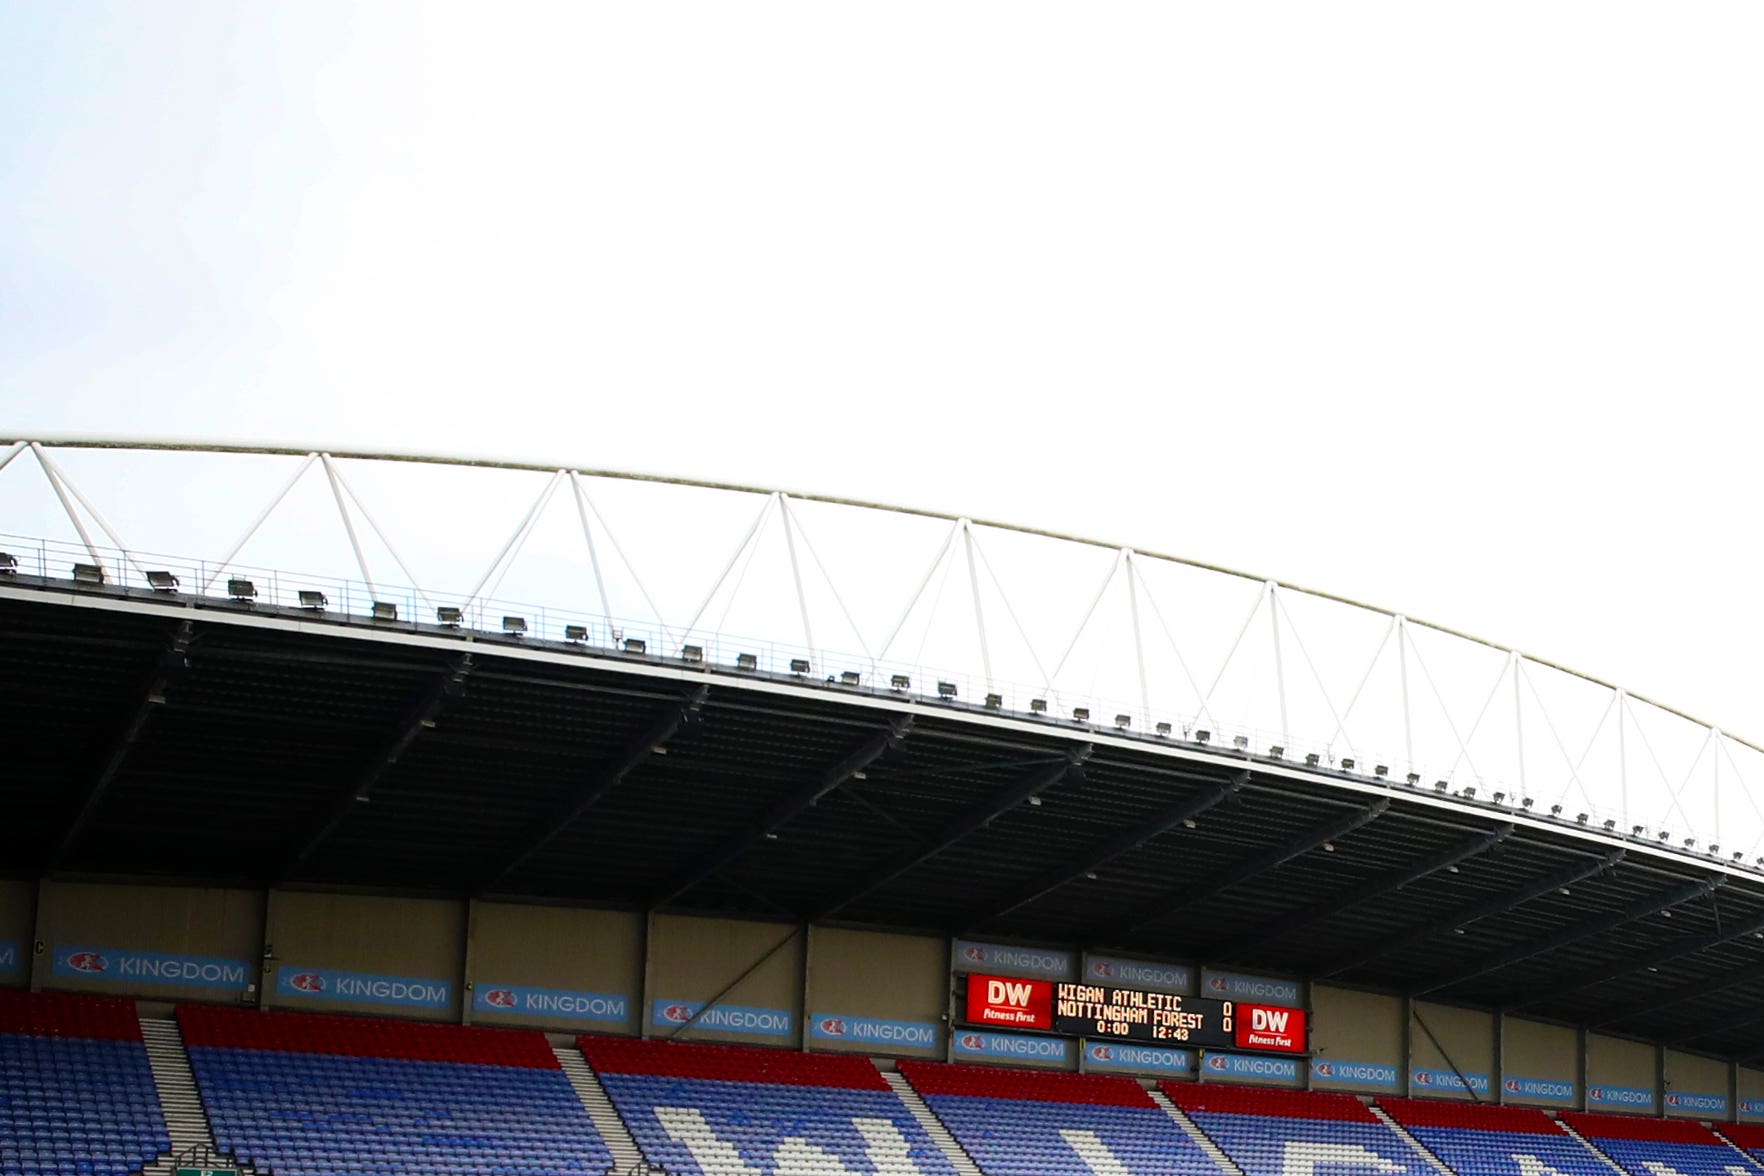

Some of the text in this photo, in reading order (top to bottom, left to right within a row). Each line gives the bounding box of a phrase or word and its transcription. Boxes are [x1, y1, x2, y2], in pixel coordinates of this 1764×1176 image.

[119, 957, 244, 982] KINGDOM
[993, 950, 1067, 972] KINGDOM
[1119, 965, 1188, 986] KINGDOM
[336, 977, 446, 1001] KINGDOM
[988, 980, 1033, 1007] DW
[1234, 979, 1296, 999] KINGDOM
[526, 993, 625, 1016] KINGDOM
[1058, 984, 1232, 1016] WIGAN ATHLETIC 0
[700, 1010, 788, 1030] KINGDOM
[1058, 1001, 1232, 1032] NOTTINGHAM FOREST 0
[1252, 1008, 1289, 1033] DW
[853, 1025, 933, 1042] KINGDOM
[1097, 1020, 1189, 1041] 0:00 12:43
[991, 1037, 1064, 1056] KINGDOM
[1119, 1048, 1186, 1066] KINGDOM
[1234, 1059, 1295, 1076] KINGDOM
[1339, 1067, 1395, 1081] KINGDOM
[1525, 1082, 1572, 1096] KINGDOM
[1606, 1091, 1651, 1105] KINGDOM
[1684, 1096, 1725, 1110] KINGDOM
